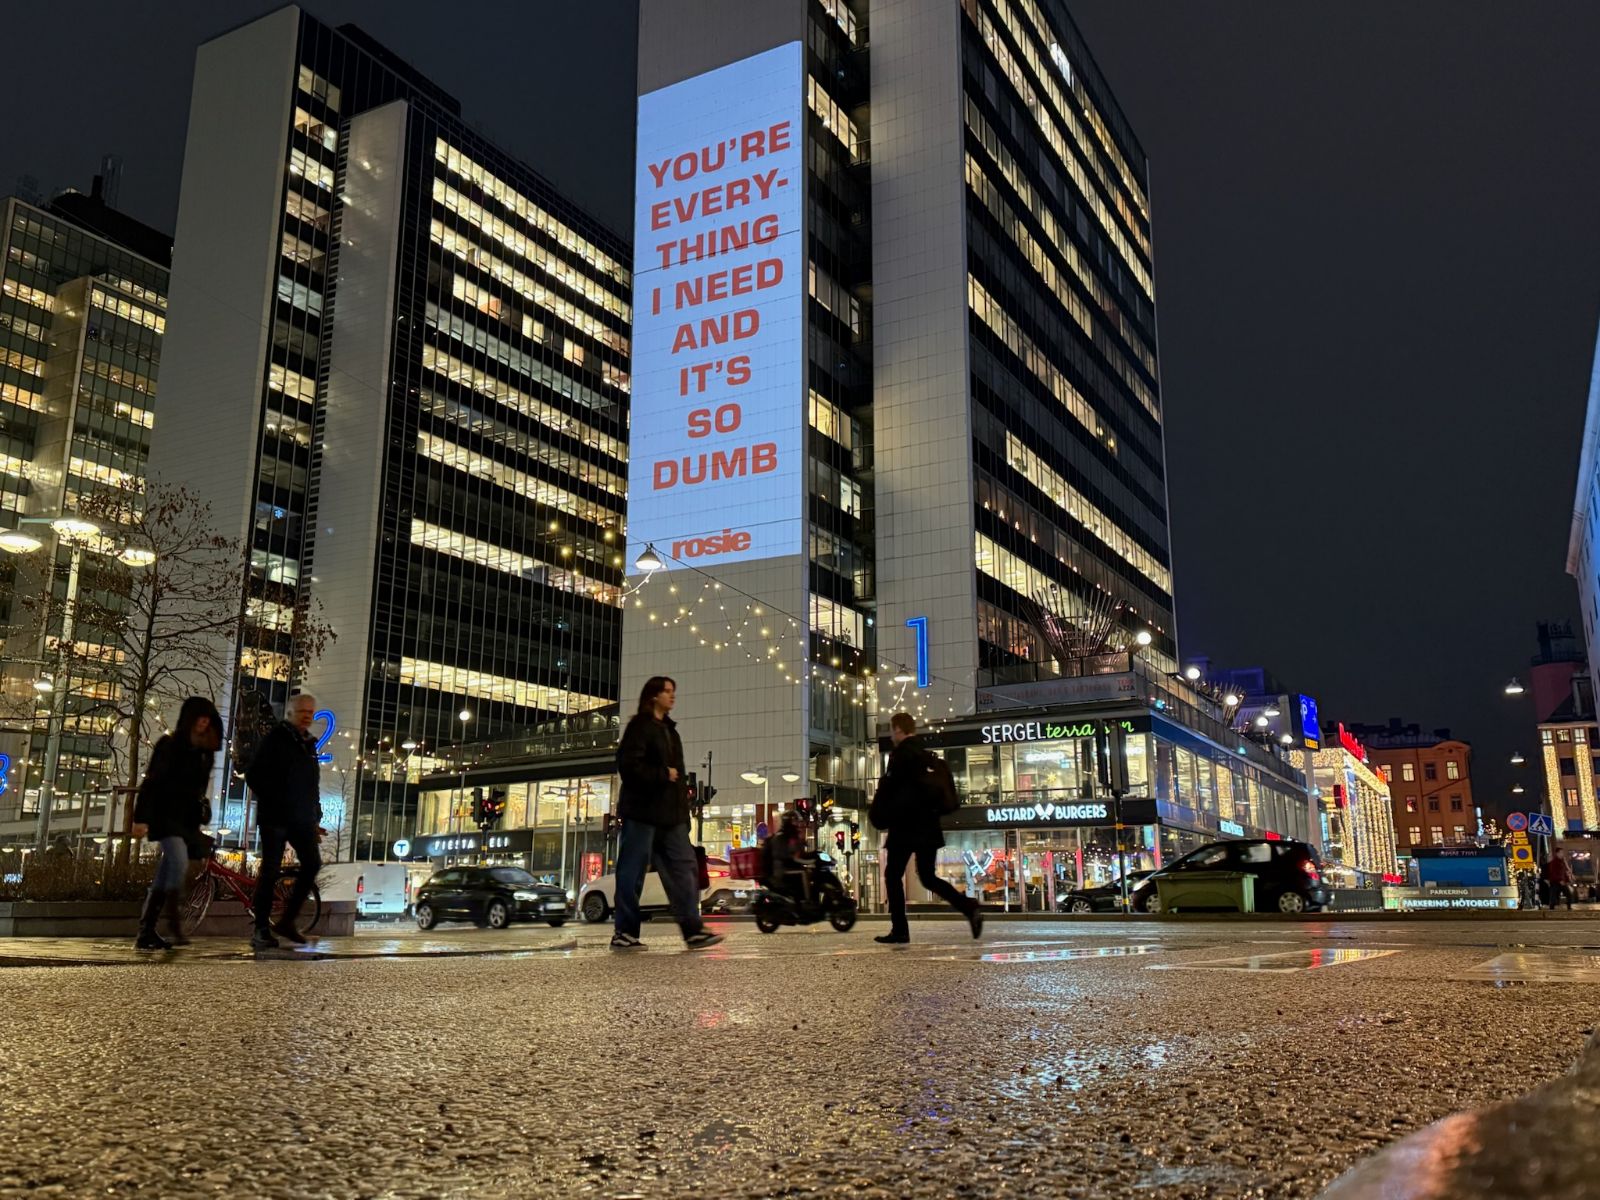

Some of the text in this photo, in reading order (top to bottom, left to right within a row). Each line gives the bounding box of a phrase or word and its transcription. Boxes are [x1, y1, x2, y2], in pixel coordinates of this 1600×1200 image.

[648, 121, 790, 188] YOU'RE
[651, 168, 788, 231] EVERY-
[656, 214, 779, 270] THING
[652, 258, 783, 315] I NEED
[672, 309, 760, 354] AND
[680, 355, 751, 396] IT'S
[687, 403, 741, 439] SO
[653, 442, 778, 490] DUMB
[672, 528, 751, 560] rosie
[905, 616, 928, 688] 1
[313, 708, 336, 763] 2
[987, 804, 1108, 822] BASTARD BURGERS
[434, 838, 475, 851] FIESTA
[1402, 899, 1450, 909] PARKERING
[1452, 898, 1499, 908] HÖTORGET
[1429, 888, 1469, 896] PARKERING
